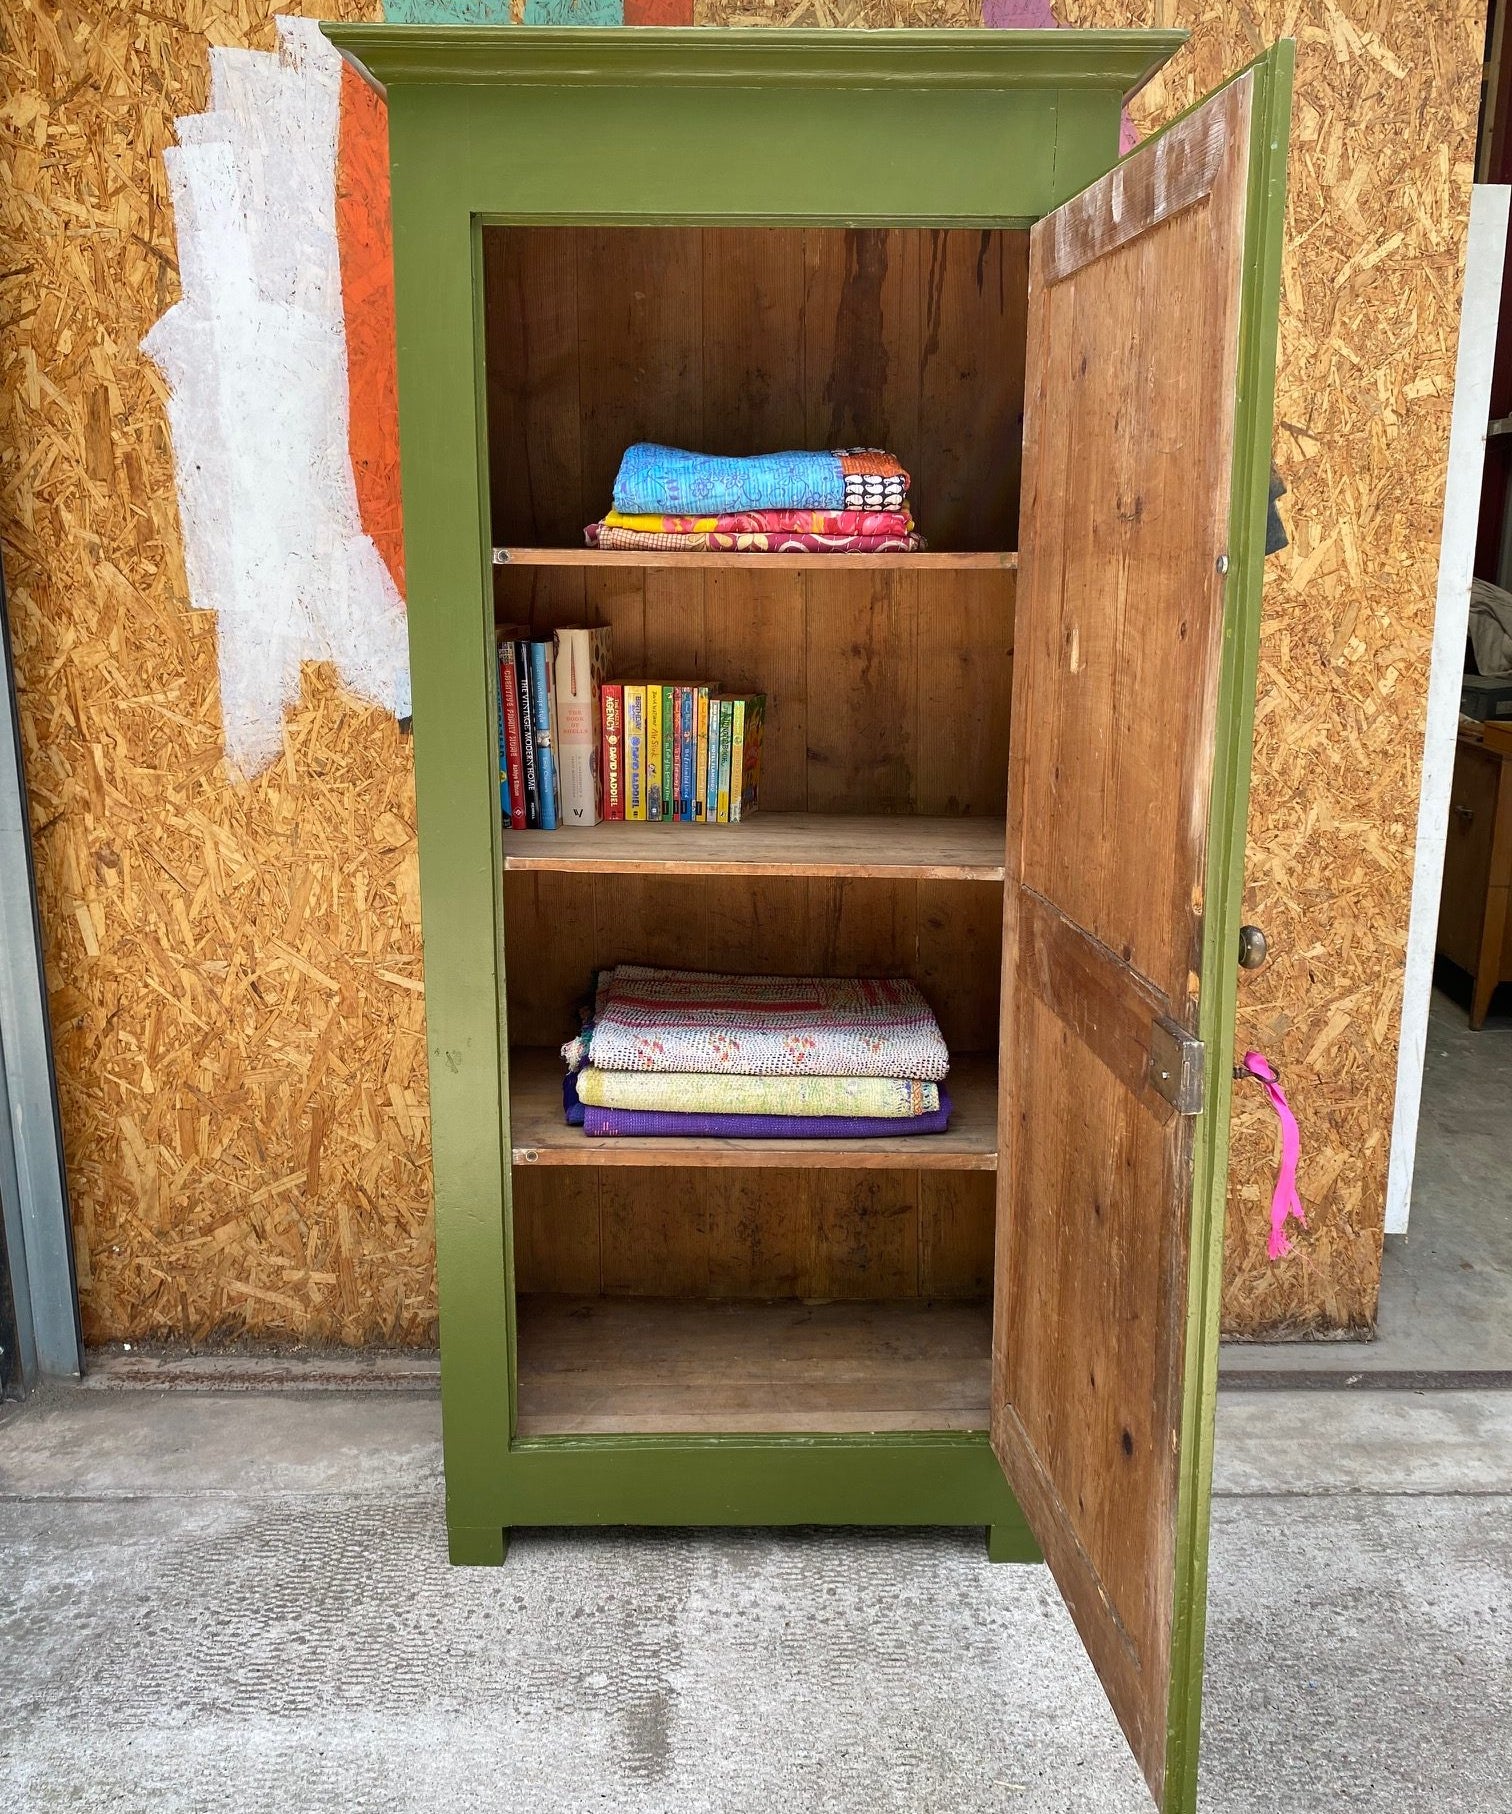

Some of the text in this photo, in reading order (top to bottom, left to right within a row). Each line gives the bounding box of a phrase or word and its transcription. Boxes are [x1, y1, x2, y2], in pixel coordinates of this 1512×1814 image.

[504, 670, 514, 707] CREATIVE
[536, 680, 545, 707] vintage
[506, 709, 516, 734] FAMILY
[522, 694, 531, 730] VINTAGE
[537, 708, 546, 723] style
[606, 696, 615, 731] AGENCY
[525, 731, 534, 766] MODERN
[527, 767, 536, 791] HOME
[609, 746, 618, 807] DAVID BADDIEL
[632, 747, 640, 809] DAVID BADDIEL
